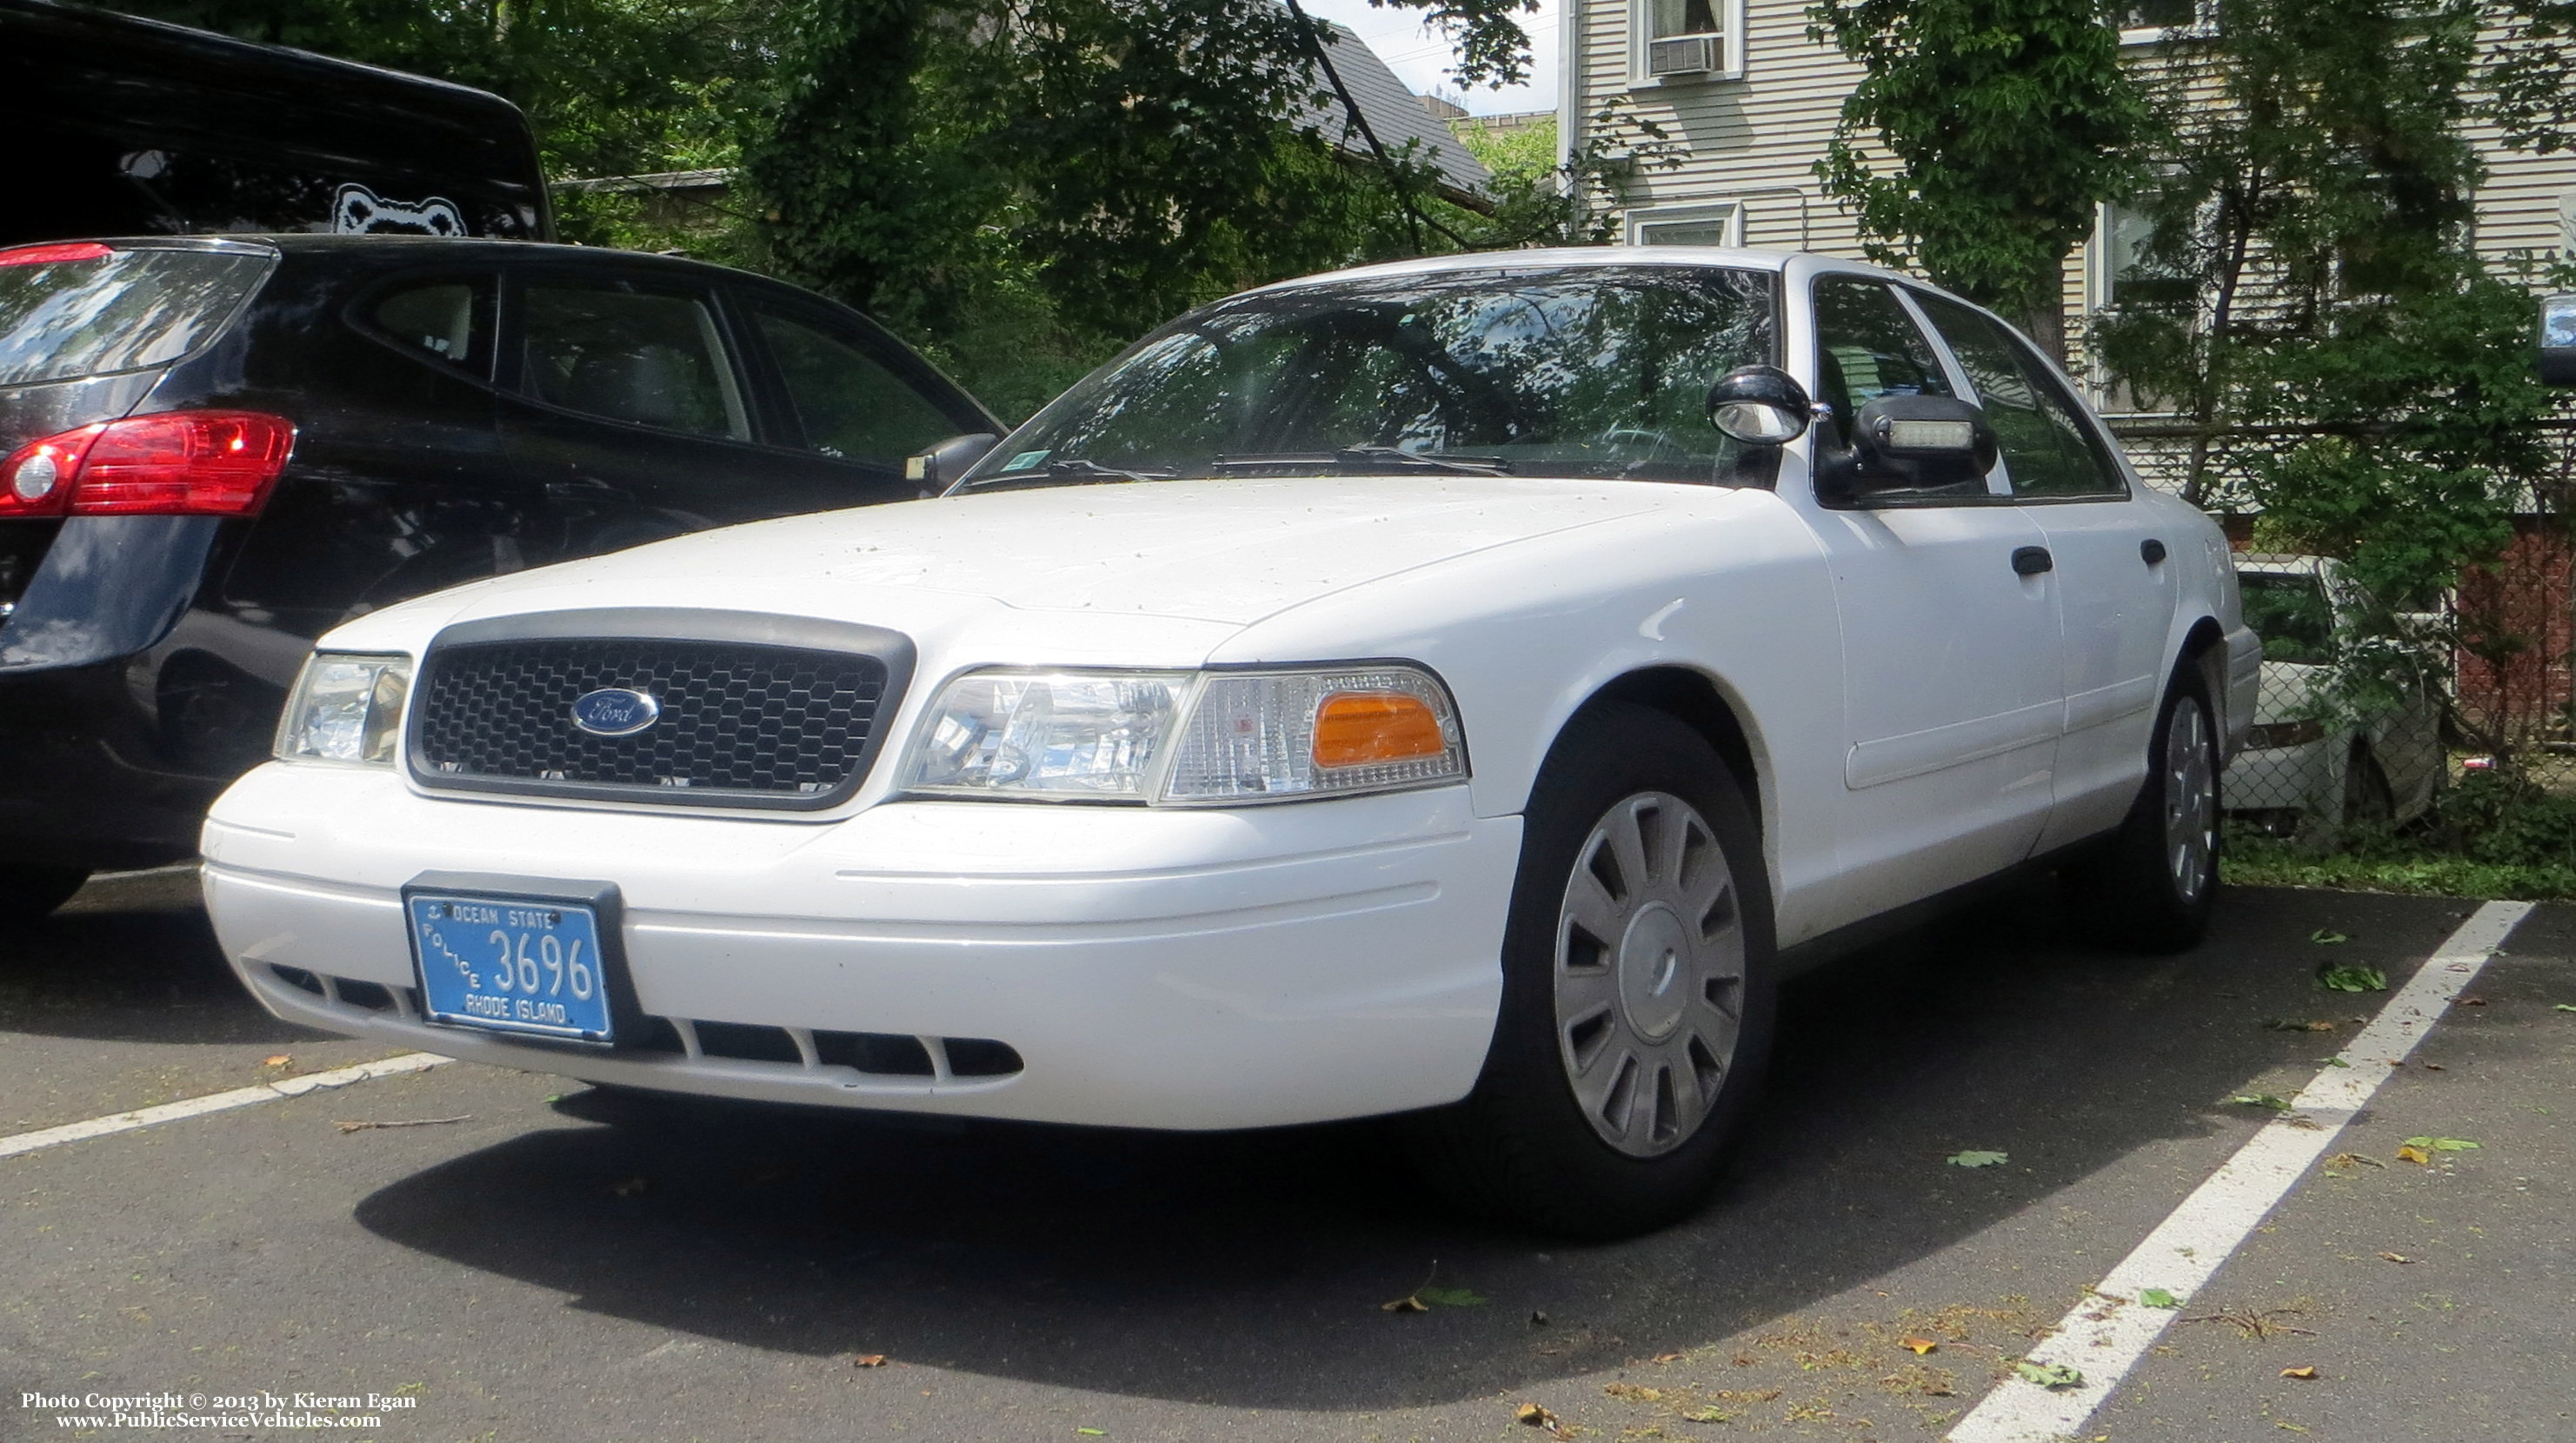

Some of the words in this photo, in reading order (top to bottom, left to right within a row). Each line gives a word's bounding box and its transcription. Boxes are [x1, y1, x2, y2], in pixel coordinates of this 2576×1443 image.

[589, 697, 636, 722] Ford
[453, 905, 498, 924] OCEAN
[509, 910, 554, 929] STATE
[423, 923, 481, 988] POLICE
[489, 929, 593, 1001] 3696
[465, 994, 511, 1017] RHODE
[516, 999, 565, 1024] ISLAND
